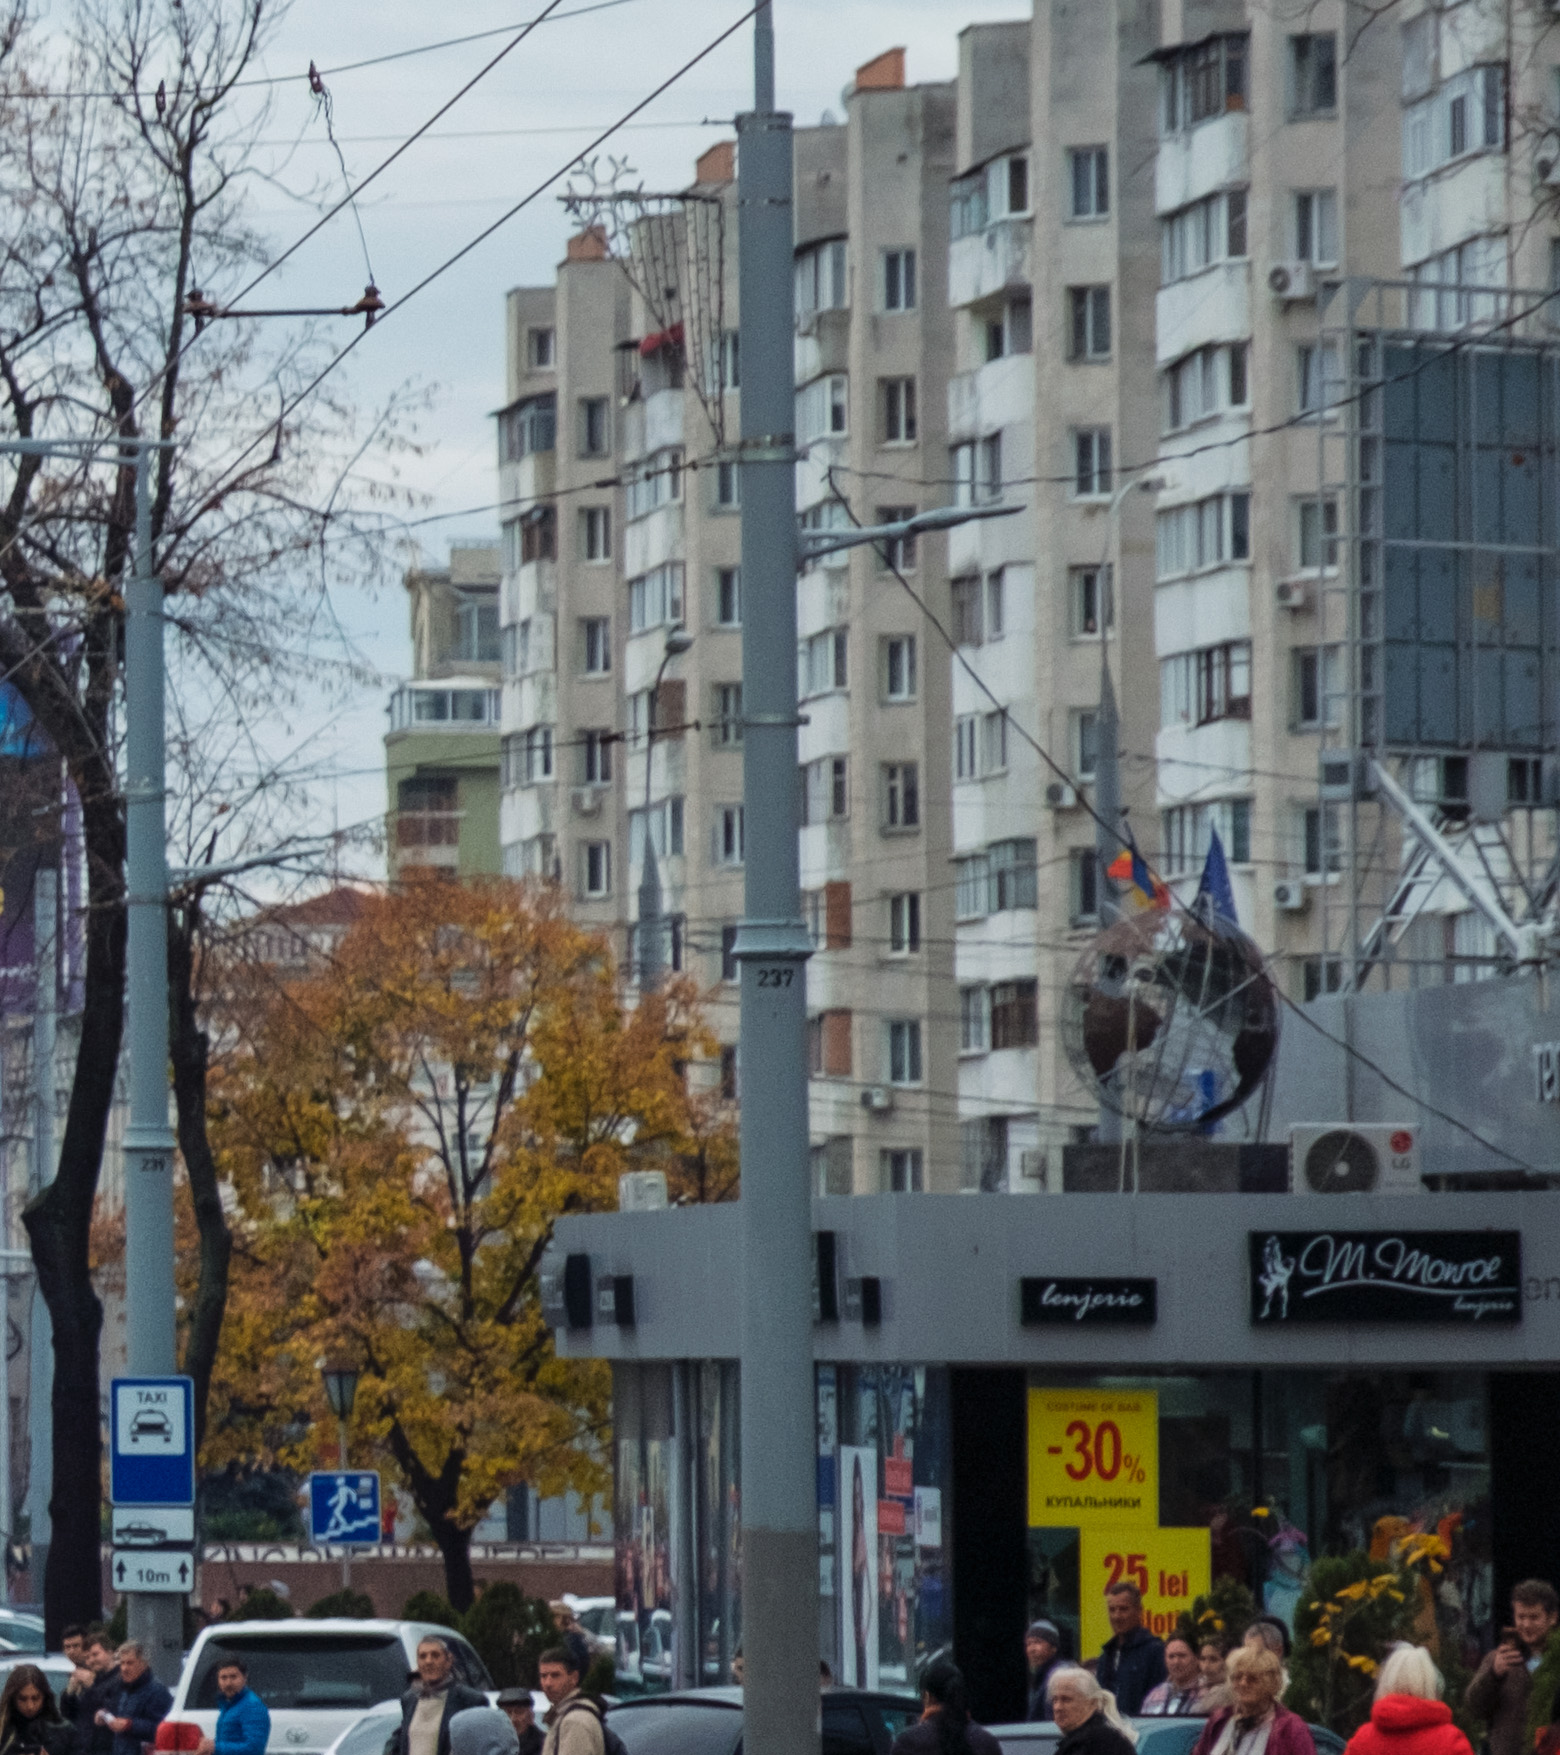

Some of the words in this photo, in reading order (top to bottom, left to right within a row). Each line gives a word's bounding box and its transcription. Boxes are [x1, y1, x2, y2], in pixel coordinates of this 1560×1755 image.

[758, 969, 795, 987] 237
[1041, 1283, 1144, 1320] lenjerie
[137, 1392, 168, 1404] TAXI
[1046, 1496, 1142, 1508] КУПАЛЬНИКИ
[137, 1569, 170, 1583] 10m
[1159, 1570, 1188, 1597] lei
